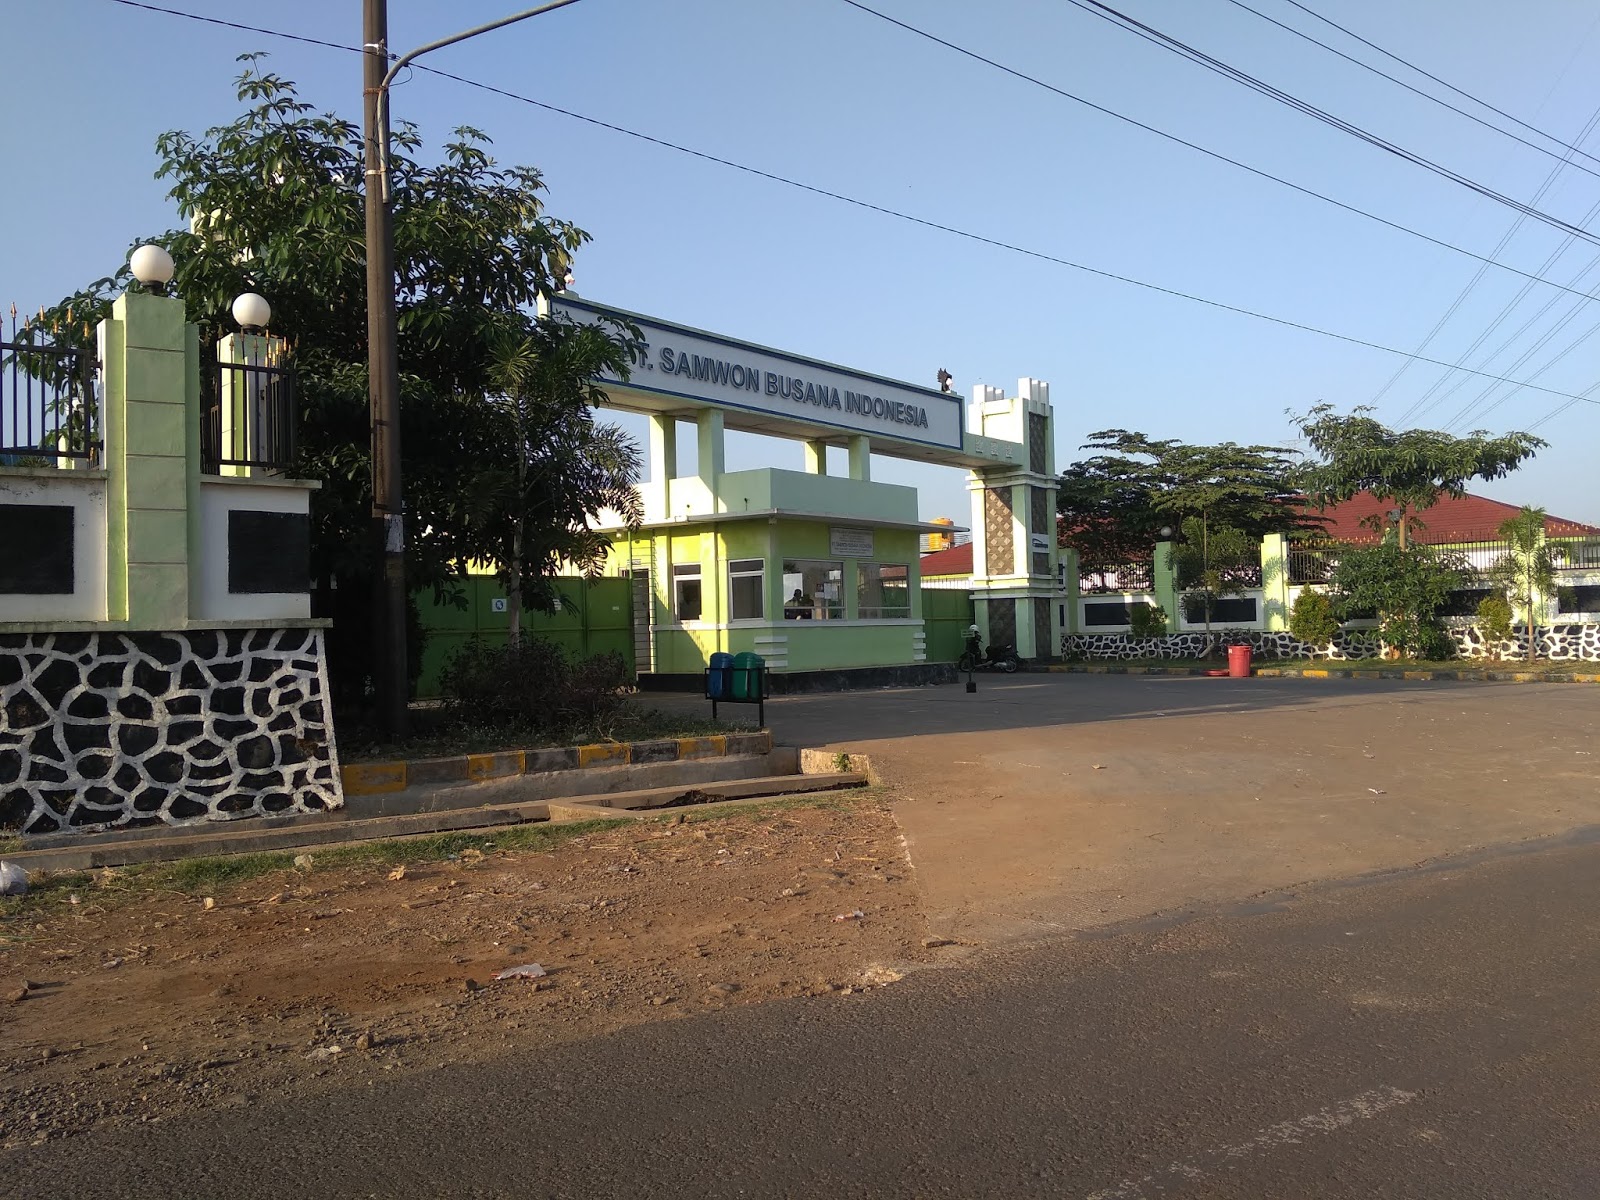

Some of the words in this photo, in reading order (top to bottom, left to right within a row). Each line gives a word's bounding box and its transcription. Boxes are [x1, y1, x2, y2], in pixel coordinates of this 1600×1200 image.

[660, 347, 760, 392] SAMWON
[765, 371, 842, 411] BUSANA
[844, 390, 929, 429] INDONESIA
